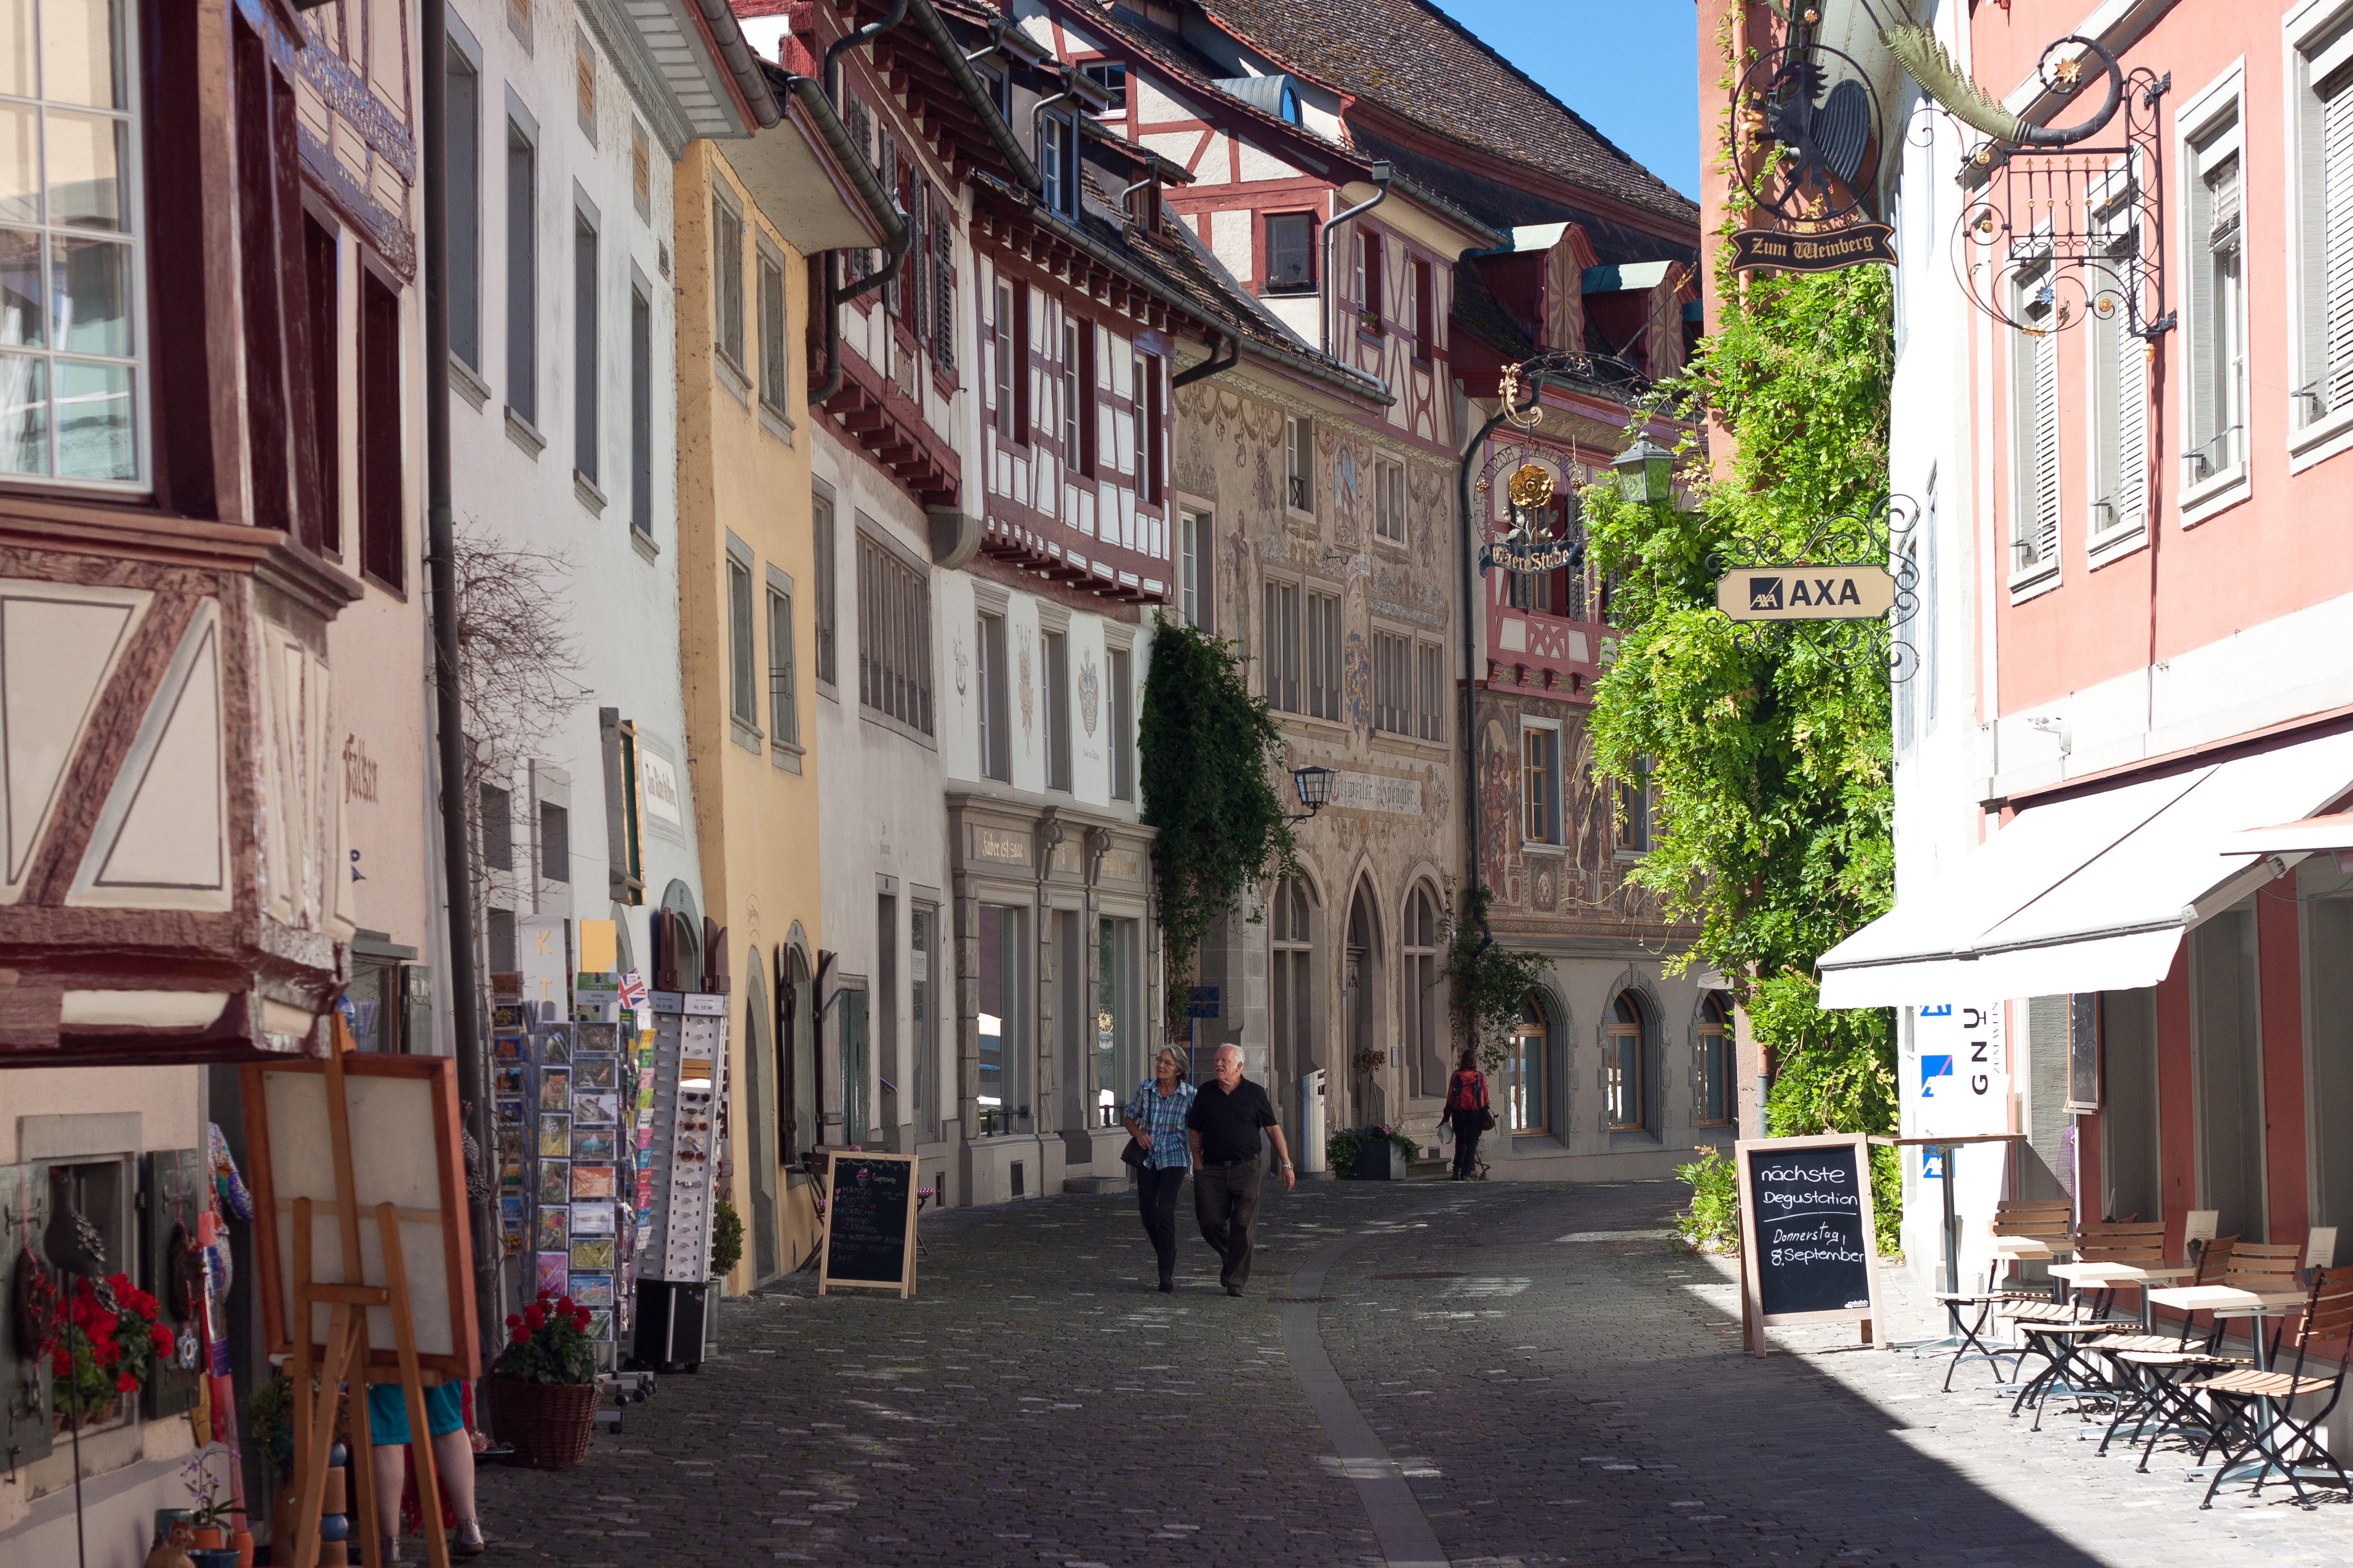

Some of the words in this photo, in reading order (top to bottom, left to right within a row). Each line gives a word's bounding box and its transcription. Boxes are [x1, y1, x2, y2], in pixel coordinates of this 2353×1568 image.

[1751, 237, 1786, 256] Zum
[1793, 235, 1874, 259] Weinberg
[1531, 547, 1570, 571] Stube
[1750, 594, 1778, 608] AXA
[1790, 579, 1861, 606] AXA
[842, 1186, 872, 1196] MANGO
[1763, 1191, 1858, 1210] Degustation
[834, 1208, 876, 1217] MACARONS
[1784, 1247, 1864, 1265] September
